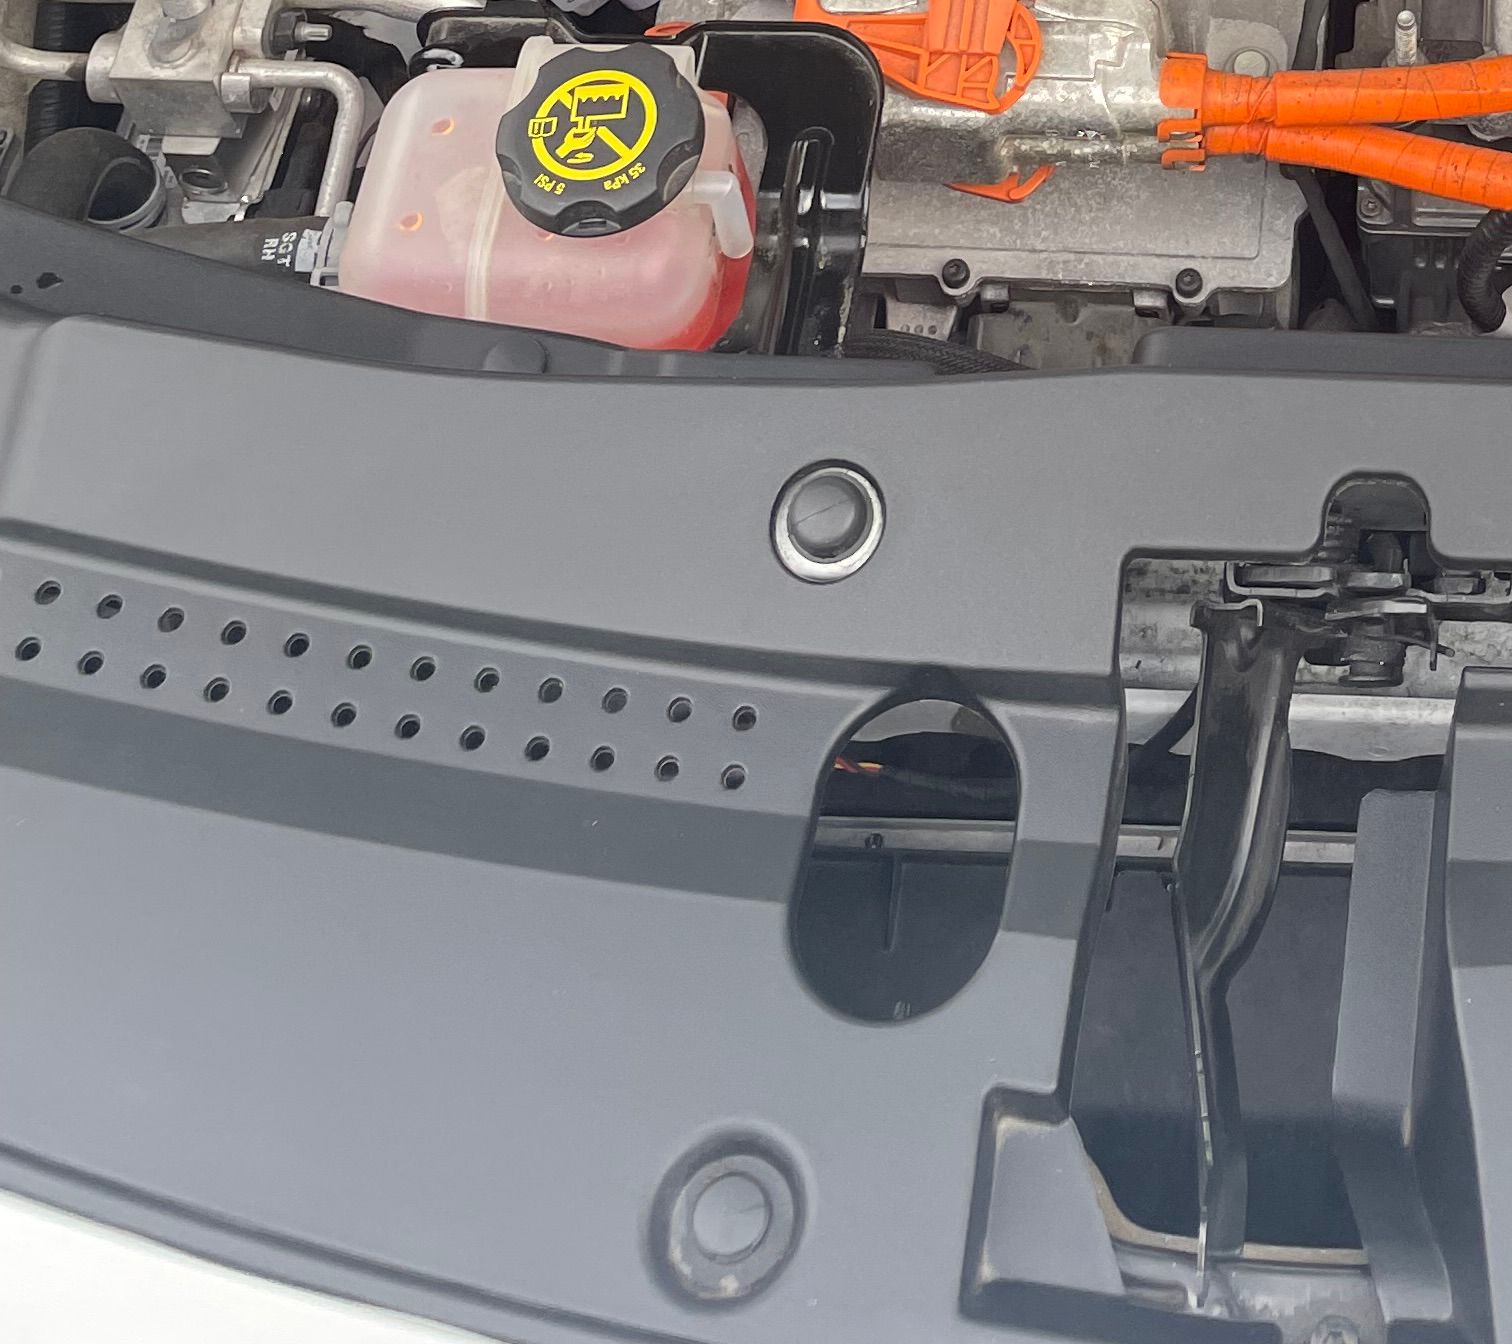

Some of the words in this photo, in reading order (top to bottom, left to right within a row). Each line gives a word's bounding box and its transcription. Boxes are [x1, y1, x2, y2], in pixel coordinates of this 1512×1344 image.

[628, 163, 646, 179] 35
[533, 173, 556, 192] PSI
[554, 182, 566, 195] 5
[603, 174, 629, 190] kPa
[261, 238, 279, 260] RH
[277, 232, 297, 267] SGT
